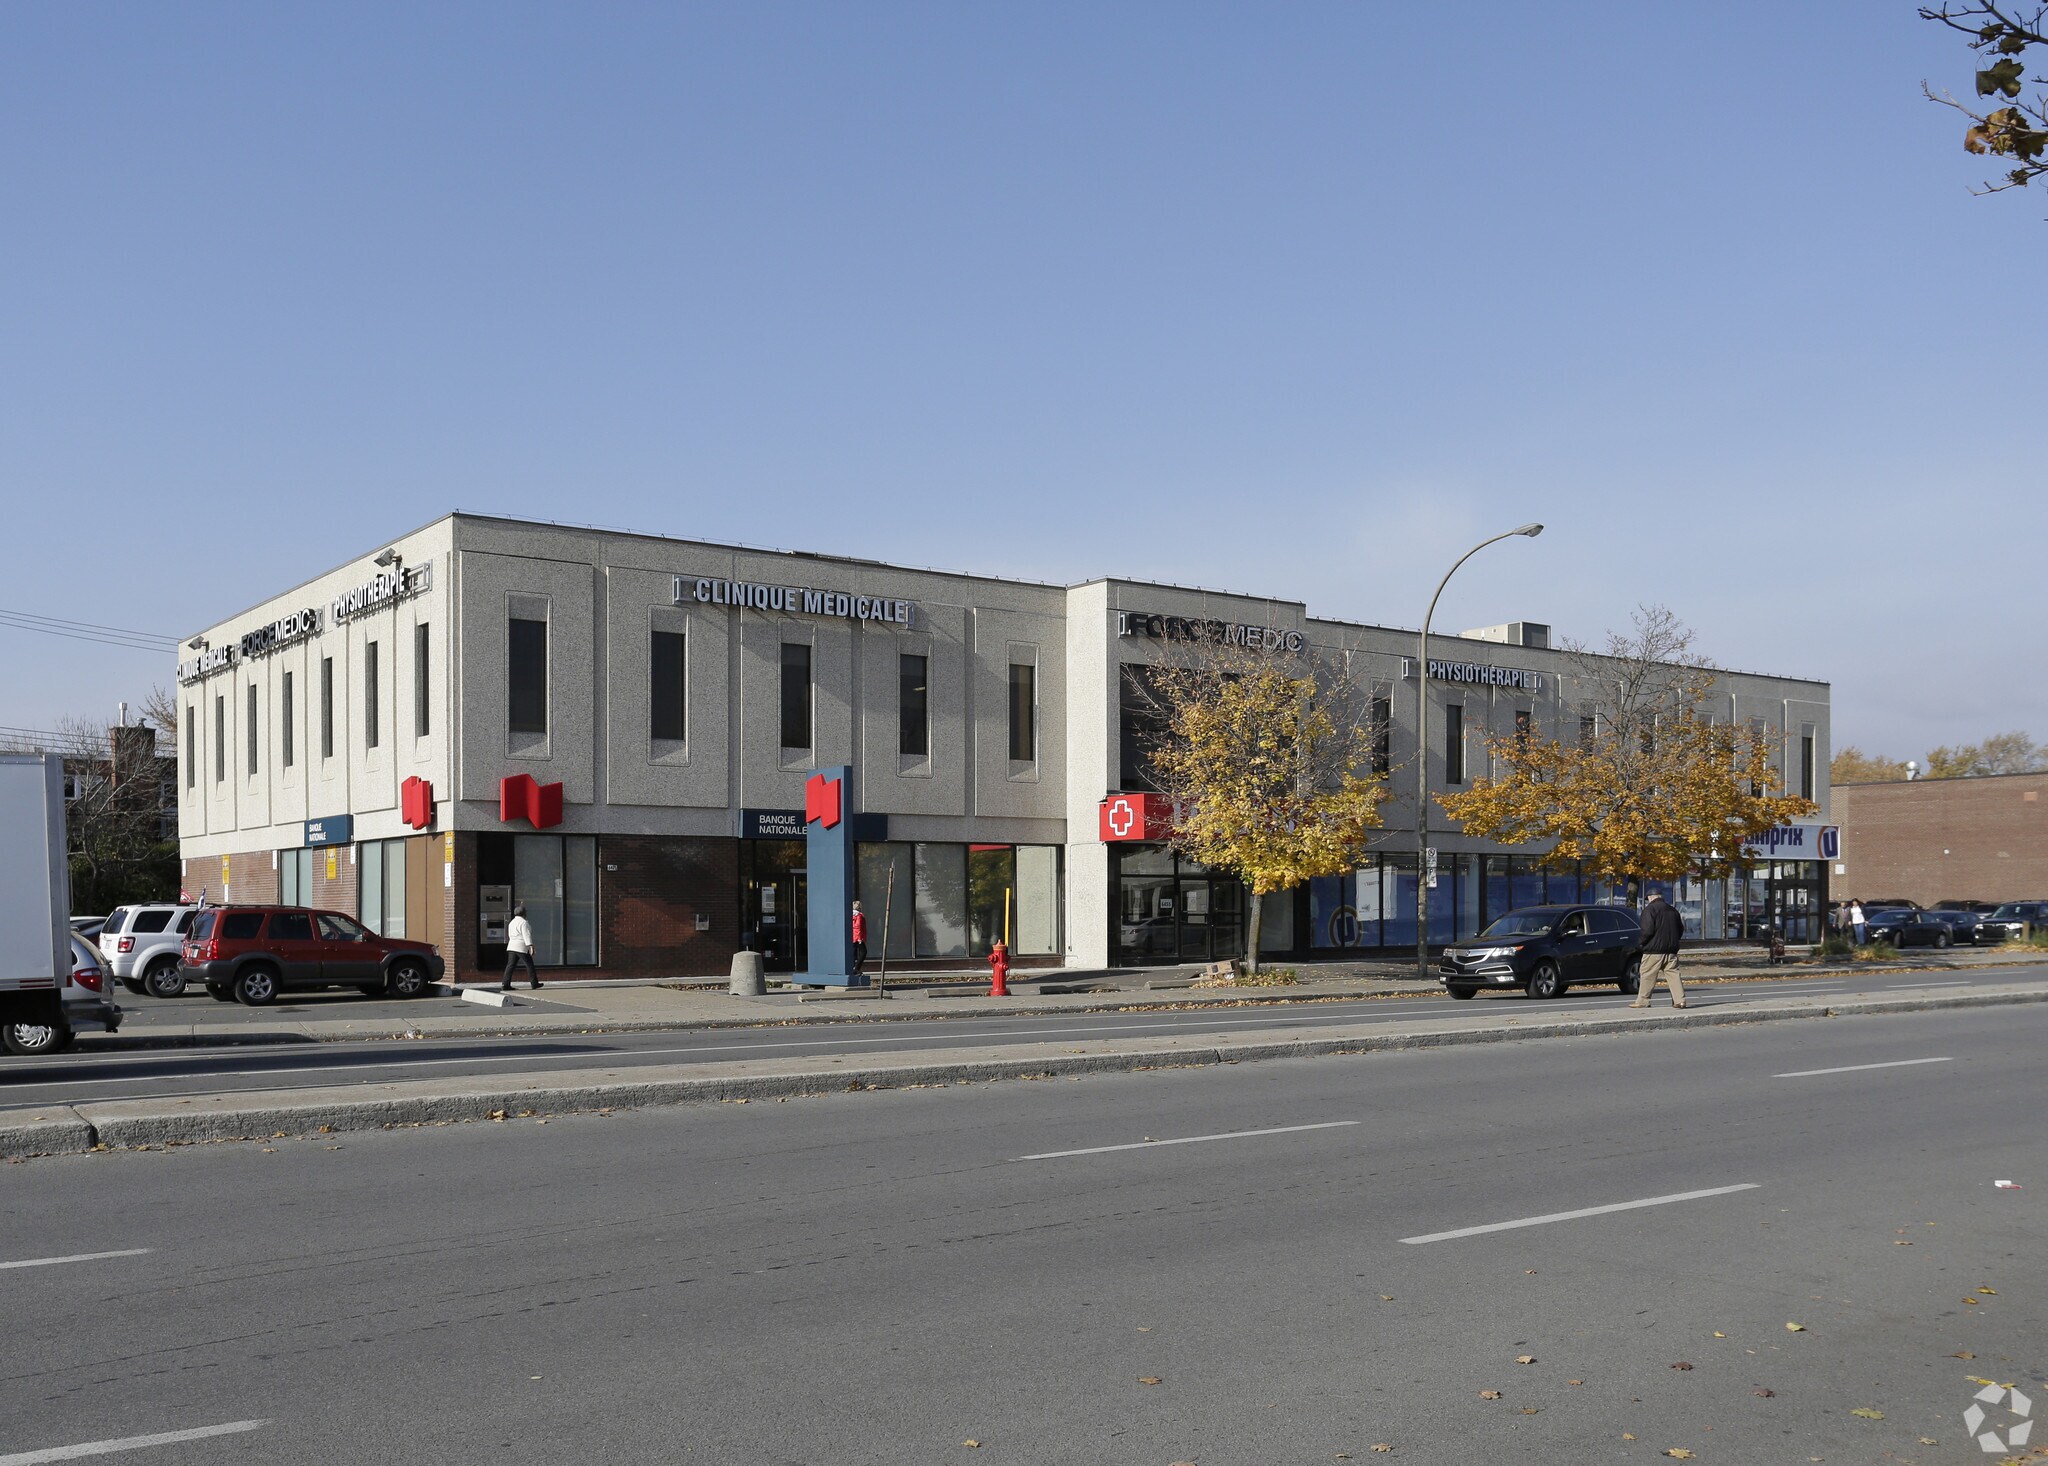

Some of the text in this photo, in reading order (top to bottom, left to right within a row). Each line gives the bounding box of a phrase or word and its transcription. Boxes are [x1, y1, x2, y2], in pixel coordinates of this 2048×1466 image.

[697, 578, 796, 611] CLINIQUE
[759, 815, 796, 825] BANQUE
[759, 826, 808, 835] NATIONALE
